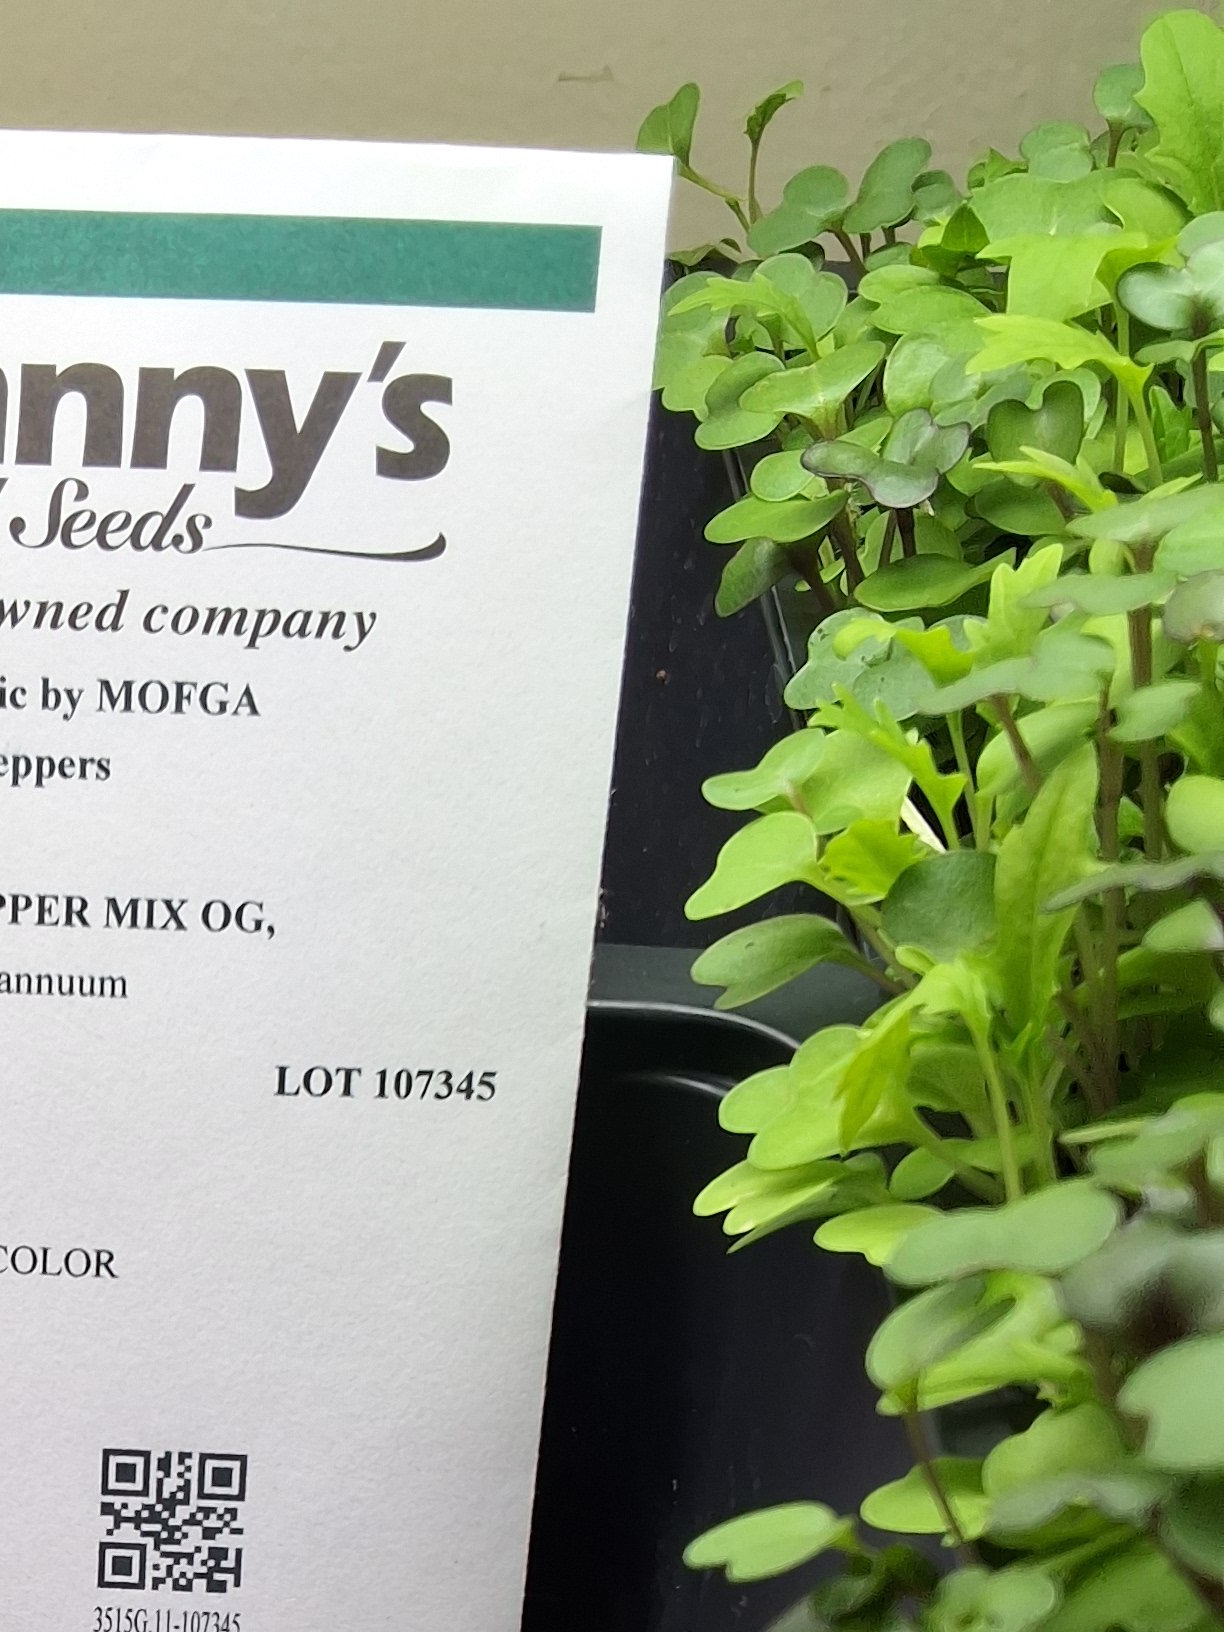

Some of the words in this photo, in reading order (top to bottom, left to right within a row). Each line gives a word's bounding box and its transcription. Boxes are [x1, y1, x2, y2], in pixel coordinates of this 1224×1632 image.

[143, 605, 376, 652] company
[42, 677, 84, 721] by
[97, 679, 260, 716] MOFGA
[105, 897, 187, 931] MIX
[202, 900, 274, 939] OG,
[275, 1066, 361, 1097] LOT
[376, 1069, 496, 1101] 107345
